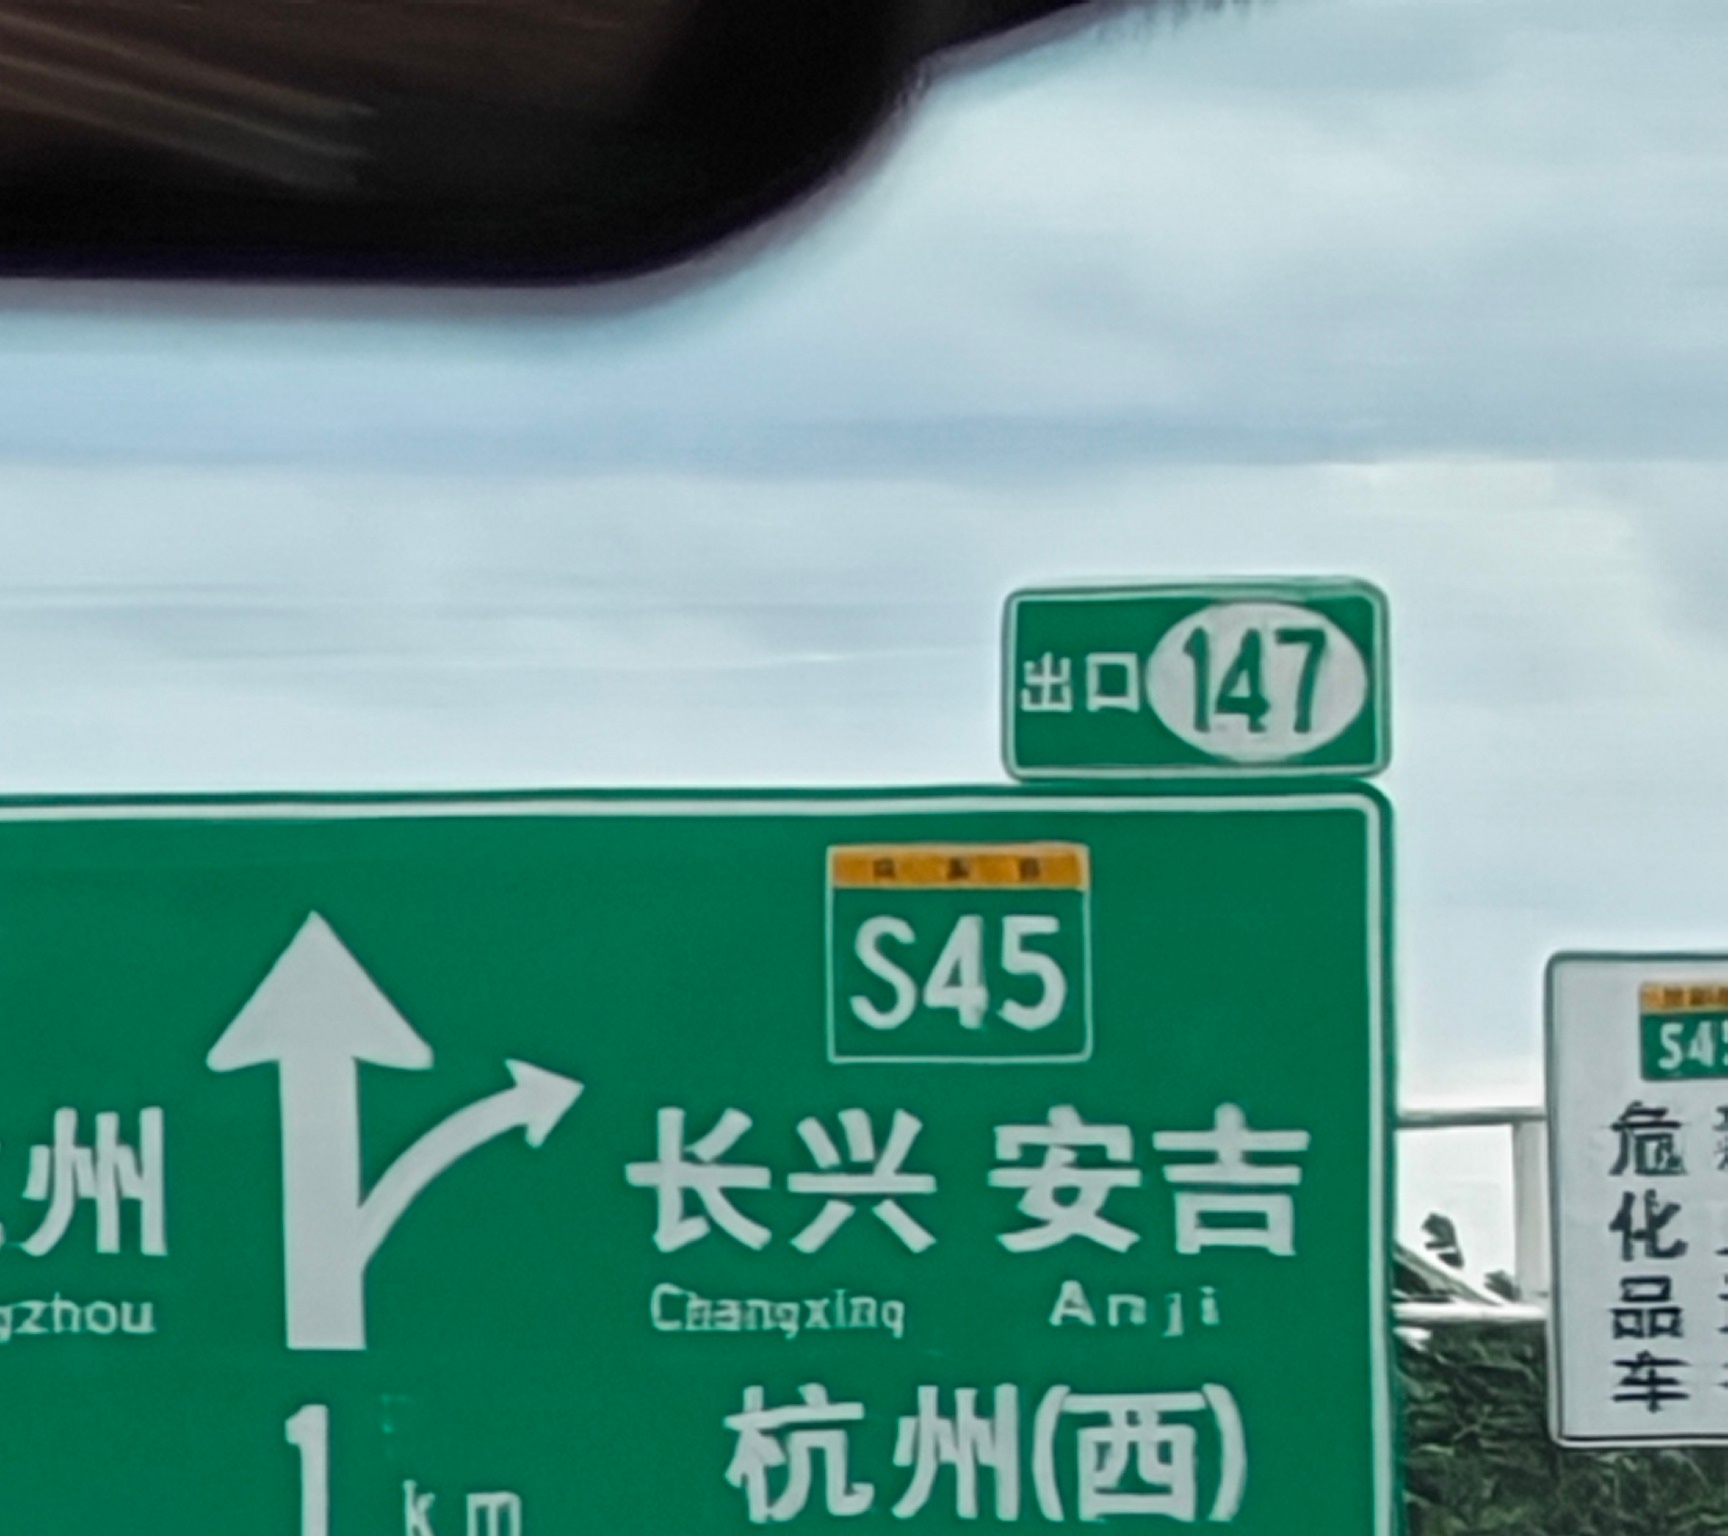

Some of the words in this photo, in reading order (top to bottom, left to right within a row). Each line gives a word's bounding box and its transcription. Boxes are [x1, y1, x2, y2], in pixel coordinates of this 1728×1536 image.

[1020, 651, 1141, 715] 出口
[1182, 626, 1330, 736] 147
[850, 914, 1068, 1031] S45
[625, 1106, 937, 1254] 长兴
[988, 1102, 1311, 1257] 安吉
[649, 1283, 906, 1338] Changxing
[1049, 1279, 1220, 1337] Anji
[724, 1382, 1249, 1524] 杭州(西)
